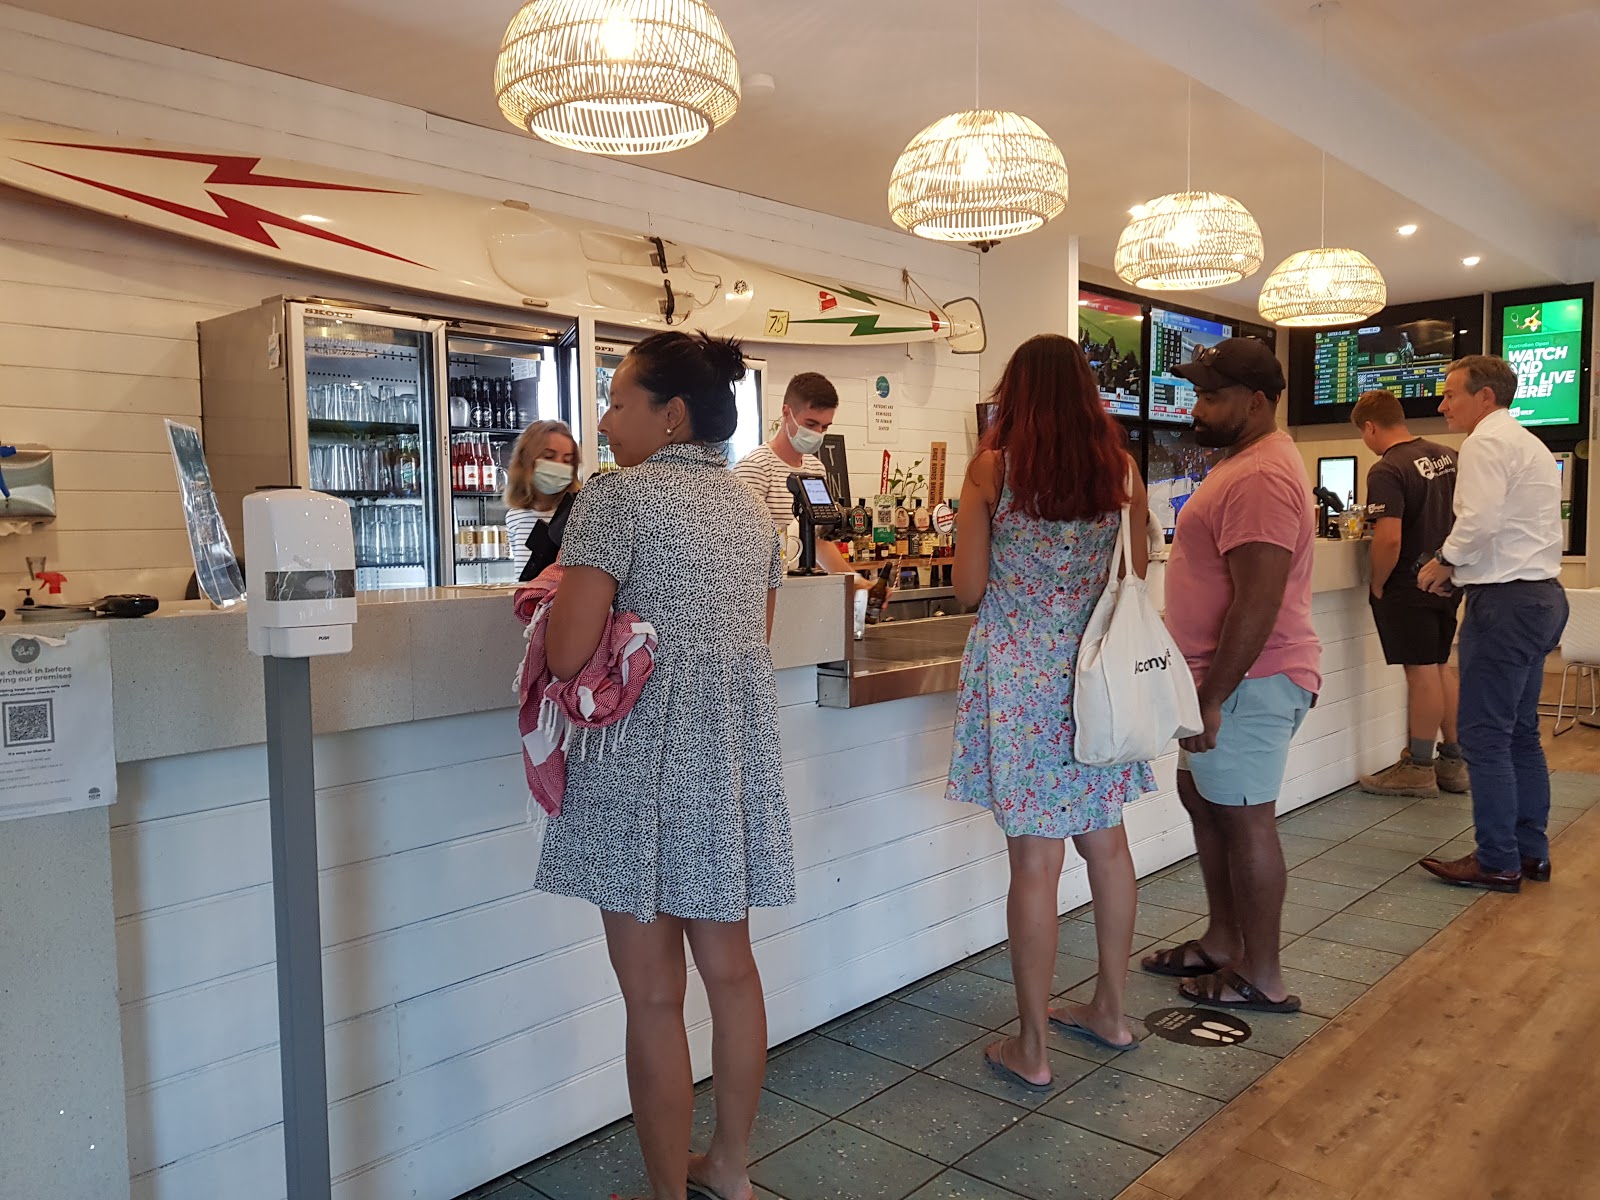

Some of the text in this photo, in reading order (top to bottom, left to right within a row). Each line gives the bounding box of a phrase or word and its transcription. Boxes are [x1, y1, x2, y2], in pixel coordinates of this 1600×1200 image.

[305, 308, 352, 319] SKOPE
[1508, 346, 1568, 363] WATCH
[1518, 370, 1576, 388] ET LIVE
[855, 516, 863, 524] VB
[7, 668, 32, 676] check
[44, 665, 72, 673] before
[35, 673, 72, 682] premises
